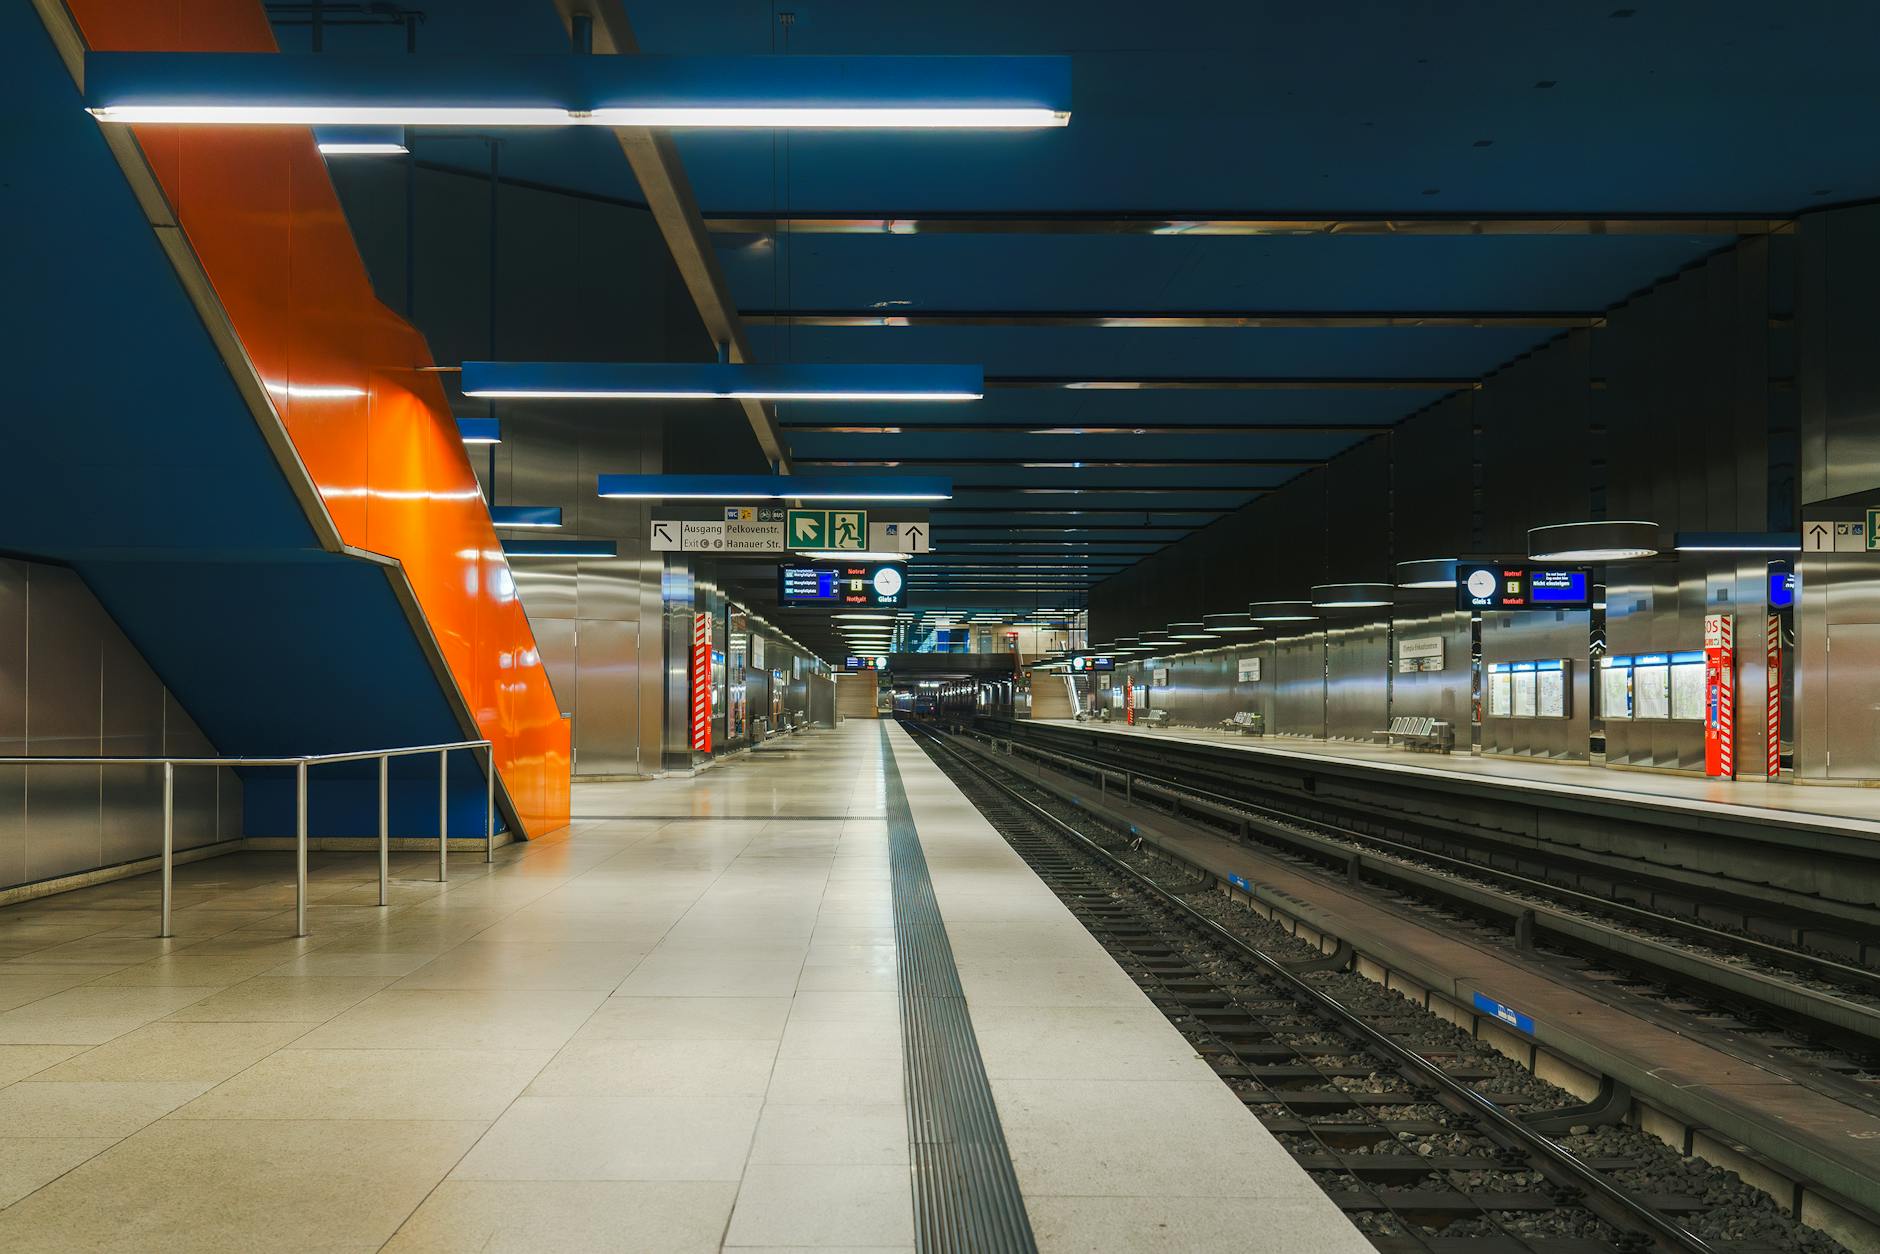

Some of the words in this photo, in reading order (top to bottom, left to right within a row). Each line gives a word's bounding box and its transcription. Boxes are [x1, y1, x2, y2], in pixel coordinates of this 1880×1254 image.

[684, 524, 722, 534] Ausgang
[727, 524, 779, 534] Pelkovenstr.
[684, 539, 699, 548] Exit
[727, 539, 763, 548] Hanauer
[766, 539, 781, 548] Str.
[1704, 620, 1719, 633] OS
